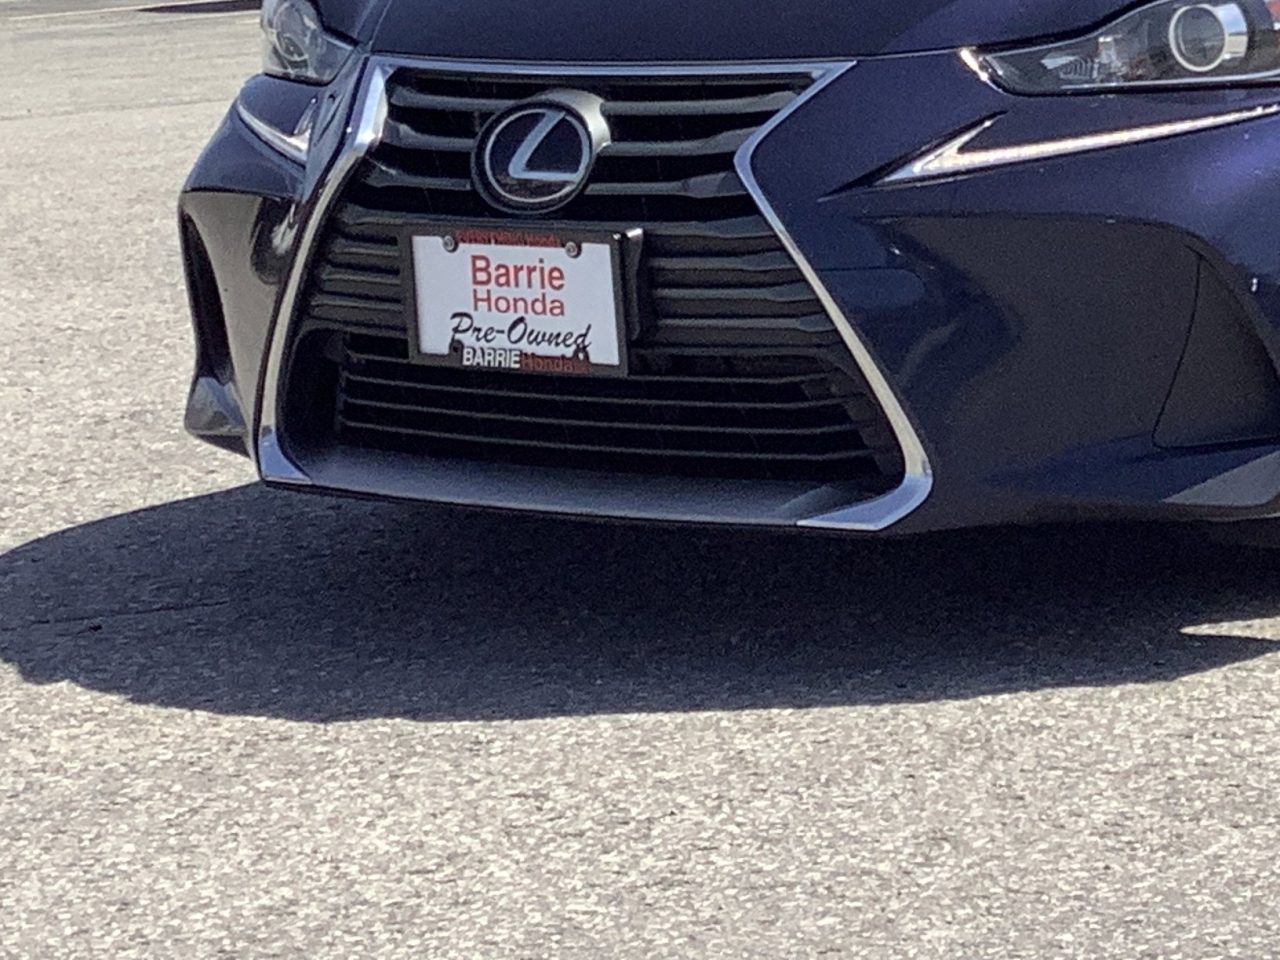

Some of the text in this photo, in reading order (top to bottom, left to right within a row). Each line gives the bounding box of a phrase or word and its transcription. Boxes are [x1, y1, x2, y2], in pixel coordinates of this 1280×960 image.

[470, 254, 566, 291] Barrie
[472, 288, 565, 317] Honda
[450, 311, 593, 349] Pre-Owned
[462, 346, 521, 369] BARRIE
